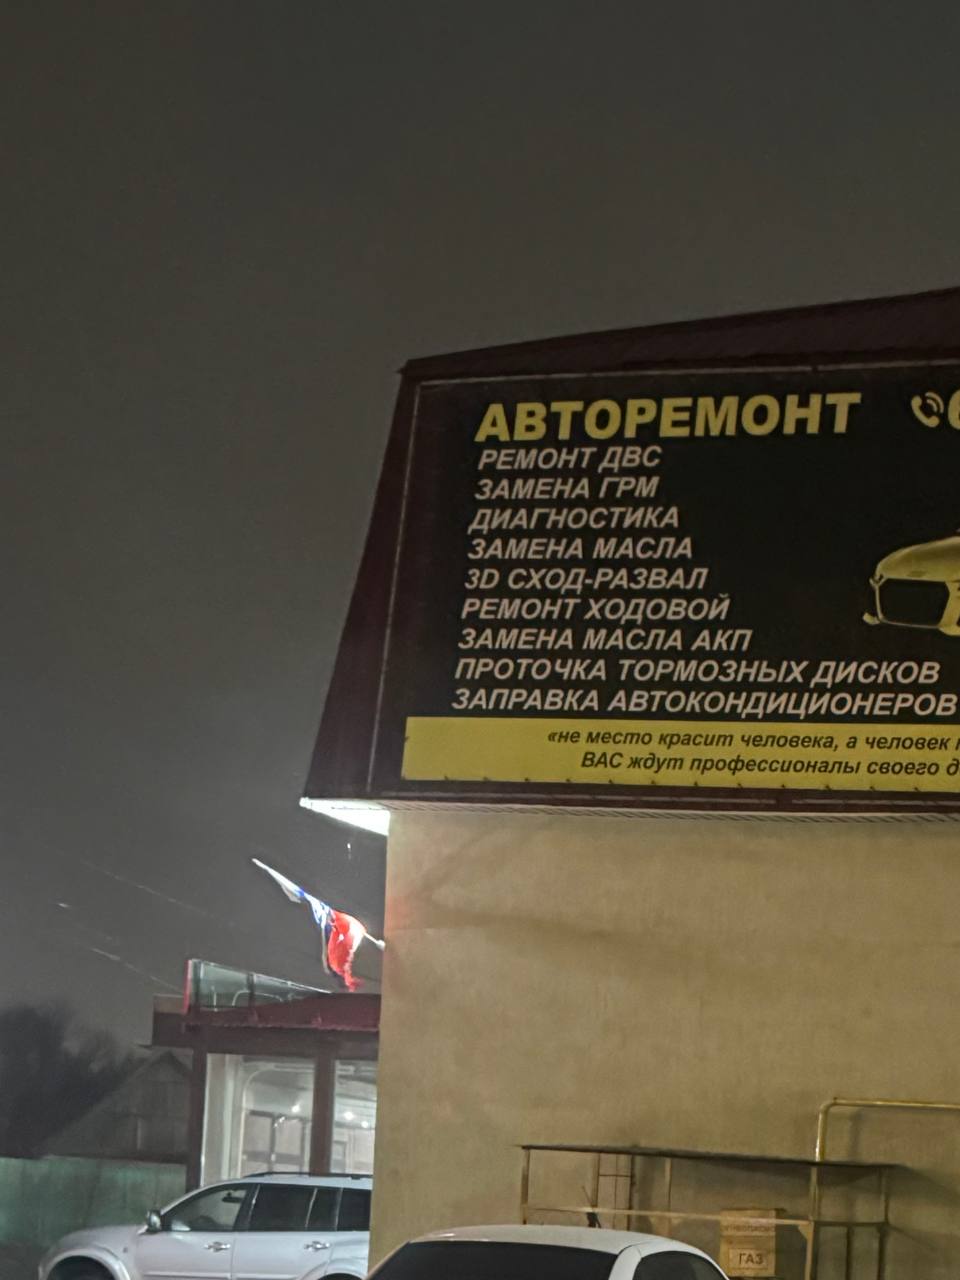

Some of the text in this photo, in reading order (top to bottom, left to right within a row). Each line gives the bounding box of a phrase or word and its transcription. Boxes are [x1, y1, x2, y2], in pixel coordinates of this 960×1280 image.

[475, 392, 862, 442] АВТОРЕМОНТ
[478, 445, 663, 474] РЕМОНТ ДВС
[474, 475, 660, 501] ЗАМЕНА ГРМ
[466, 506, 680, 535] ДИАГНОСТИКА
[467, 536, 693, 560] ЗАМЕНА МАСЛА
[464, 567, 709, 596] 3D СХОД-РАЗВАЛ
[460, 593, 730, 626] РЕМОНТ ХОДОВОЙ
[457, 627, 754, 652] ЗАМЕНА МАСЛА АКП
[454, 656, 942, 689] ПРОТОЧКА ТОРМОЗНЫХ ДИСКОВ
[450, 687, 959, 718] ЗАПРАВКА АВТОКОНДИЦИОНЕРОВ
[547, 731, 581, 743] «не
[586, 732, 653, 746] место
[658, 732, 734, 750] красит
[741, 734, 839, 752] человека,
[845, 736, 858, 749] а
[865, 737, 952, 751] человек
[580, 751, 624, 769] ВАС
[627, 752, 684, 774] ждут
[689, 755, 862, 776] профессионалы
[866, 759, 940, 776] своего
[738, 1252, 764, 1265] ГАЗ
